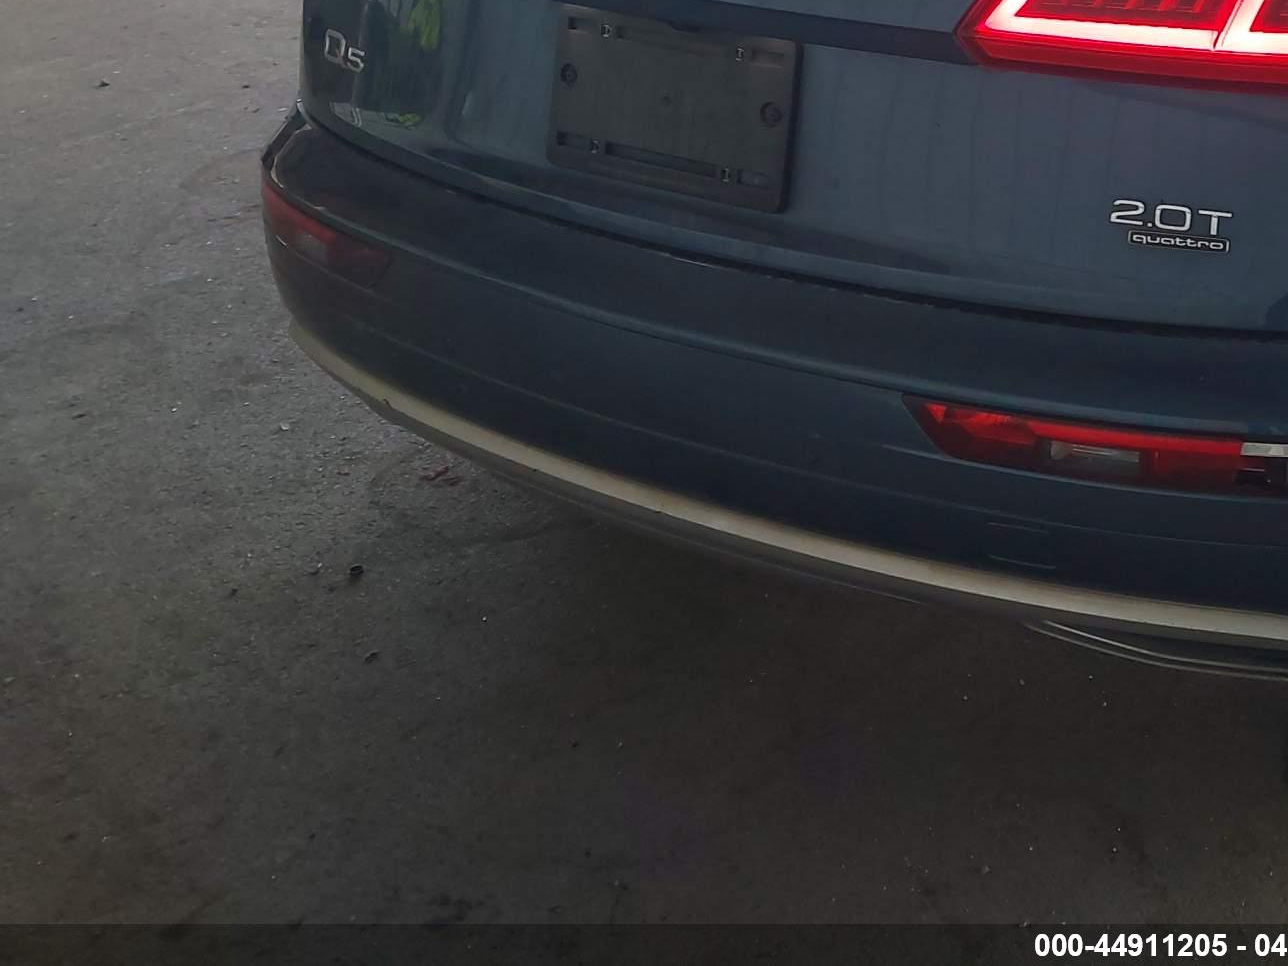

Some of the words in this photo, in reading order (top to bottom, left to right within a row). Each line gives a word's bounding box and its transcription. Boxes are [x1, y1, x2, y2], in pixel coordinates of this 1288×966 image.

[324, 28, 366, 73] Q5
[1110, 199, 1233, 235] 2.0T
[1132, 234, 1224, 250] quattro
